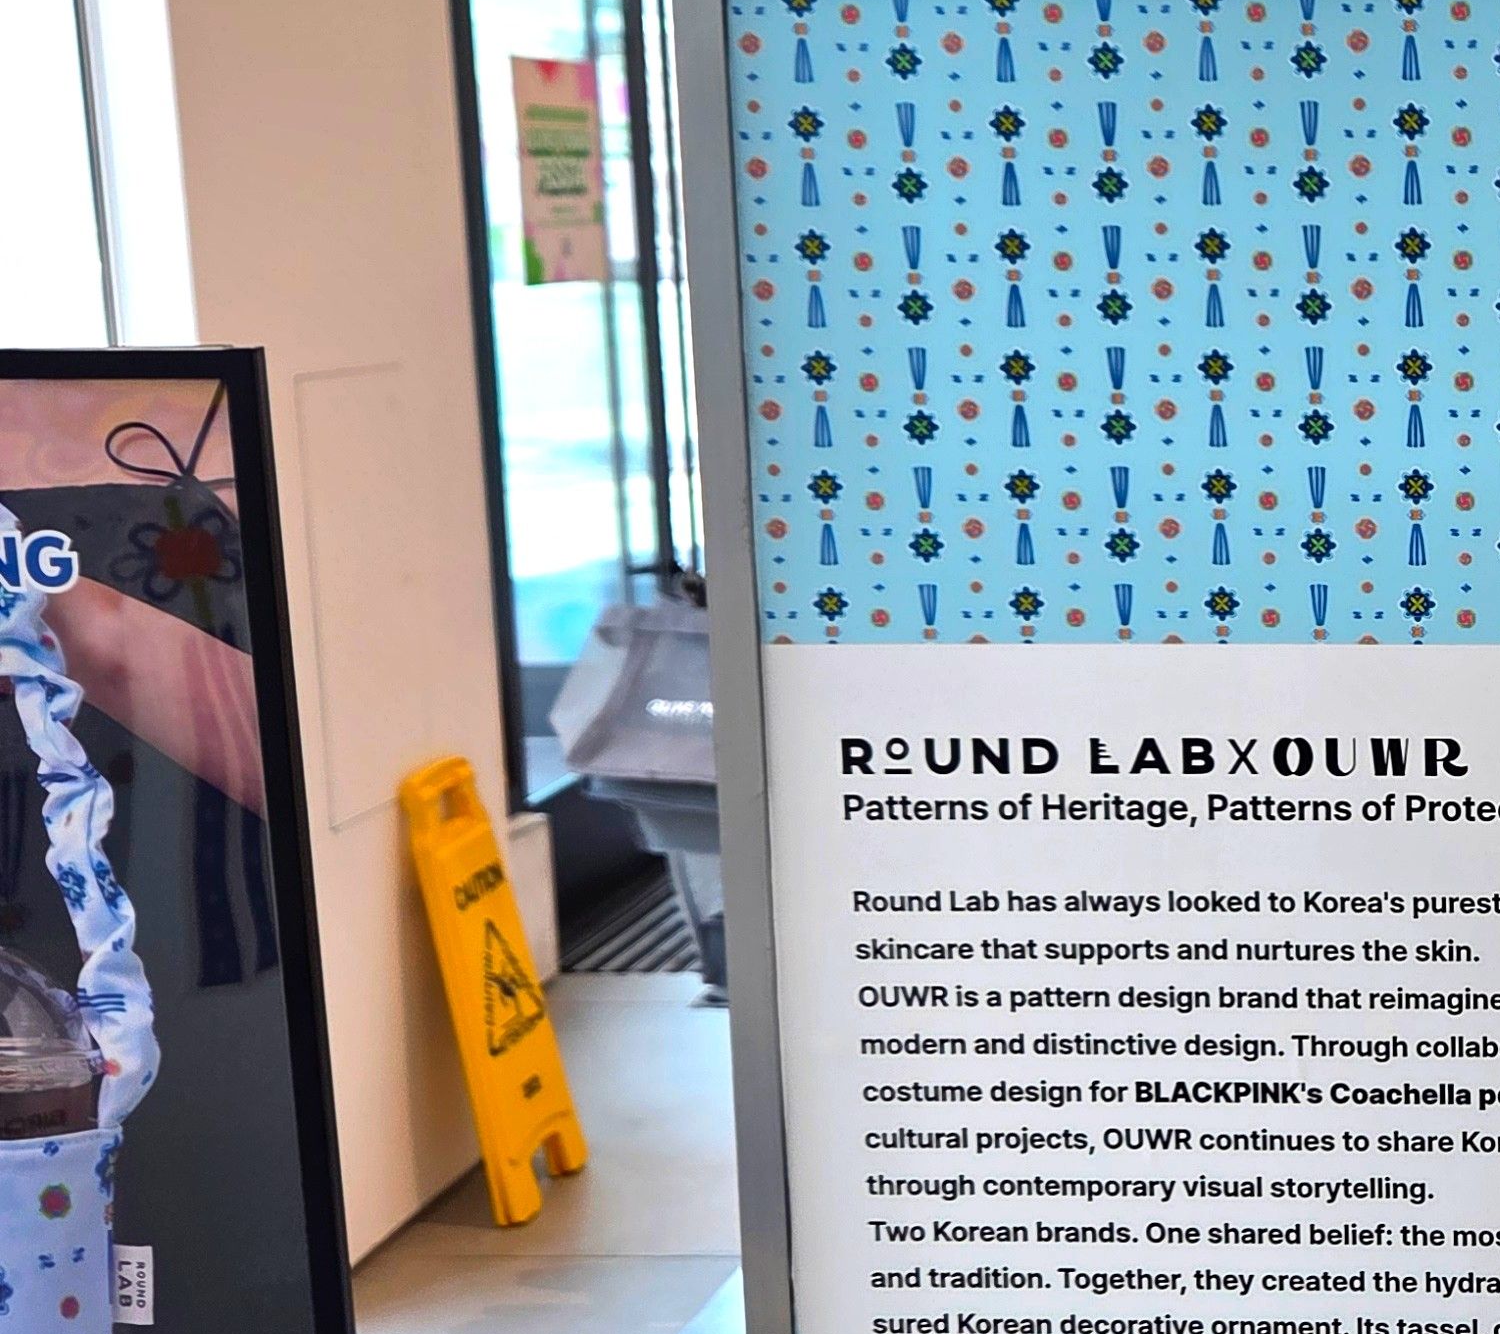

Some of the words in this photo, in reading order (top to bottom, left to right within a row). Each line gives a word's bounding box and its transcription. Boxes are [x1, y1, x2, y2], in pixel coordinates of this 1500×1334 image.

[841, 737, 1059, 775] ROUND
[842, 793, 990, 821] Patterns
[997, 792, 1034, 821] of
[1040, 791, 1198, 828] Heritage,
[1207, 793, 1353, 822] Patterns
[1361, 792, 1397, 822] of
[852, 889, 943, 913] Round
[948, 889, 1001, 913] Lab
[1006, 889, 1058, 913] has
[1063, 889, 1162, 918] always
[1167, 889, 1261, 913] looked
[1266, 891, 1297, 914] to
[1303, 890, 1406, 914] Korea's
[854, 936, 975, 961] skincare
[979, 937, 1039, 960] that
[1043, 939, 1170, 966] supports
[1176, 937, 1229, 961] and
[1235, 939, 1356, 962] nurtures
[1361, 938, 1409, 963] the
[1414, 938, 1481, 963] skin.
[857, 985, 950, 1008] OUWR
[954, 984, 980, 1008] is
[985, 990, 1003, 1008] a
[1009, 986, 1111, 1014] pattern
[1117, 984, 1211, 1014] design
[1217, 985, 1299, 1010] brand
[1304, 987, 1363, 1010] that
[862, 1081, 984, 1103] costume
[989, 1079, 1083, 1109] design
[1087, 1079, 1130, 1103] for
[1134, 1080, 1324, 1105] BLACKPINK's
[1329, 1082, 1472, 1106] Coachella
[864, 1174, 976, 1202] through
[982, 1175, 1177, 1203] contemporary
[1181, 1174, 1264, 1198] visual
[1269, 1176, 1435, 1206] storytelling.
[117, 1260, 133, 1307] LAB
[135, 1261, 147, 1309] ROUND
[871, 1312, 950, 1334] sured
